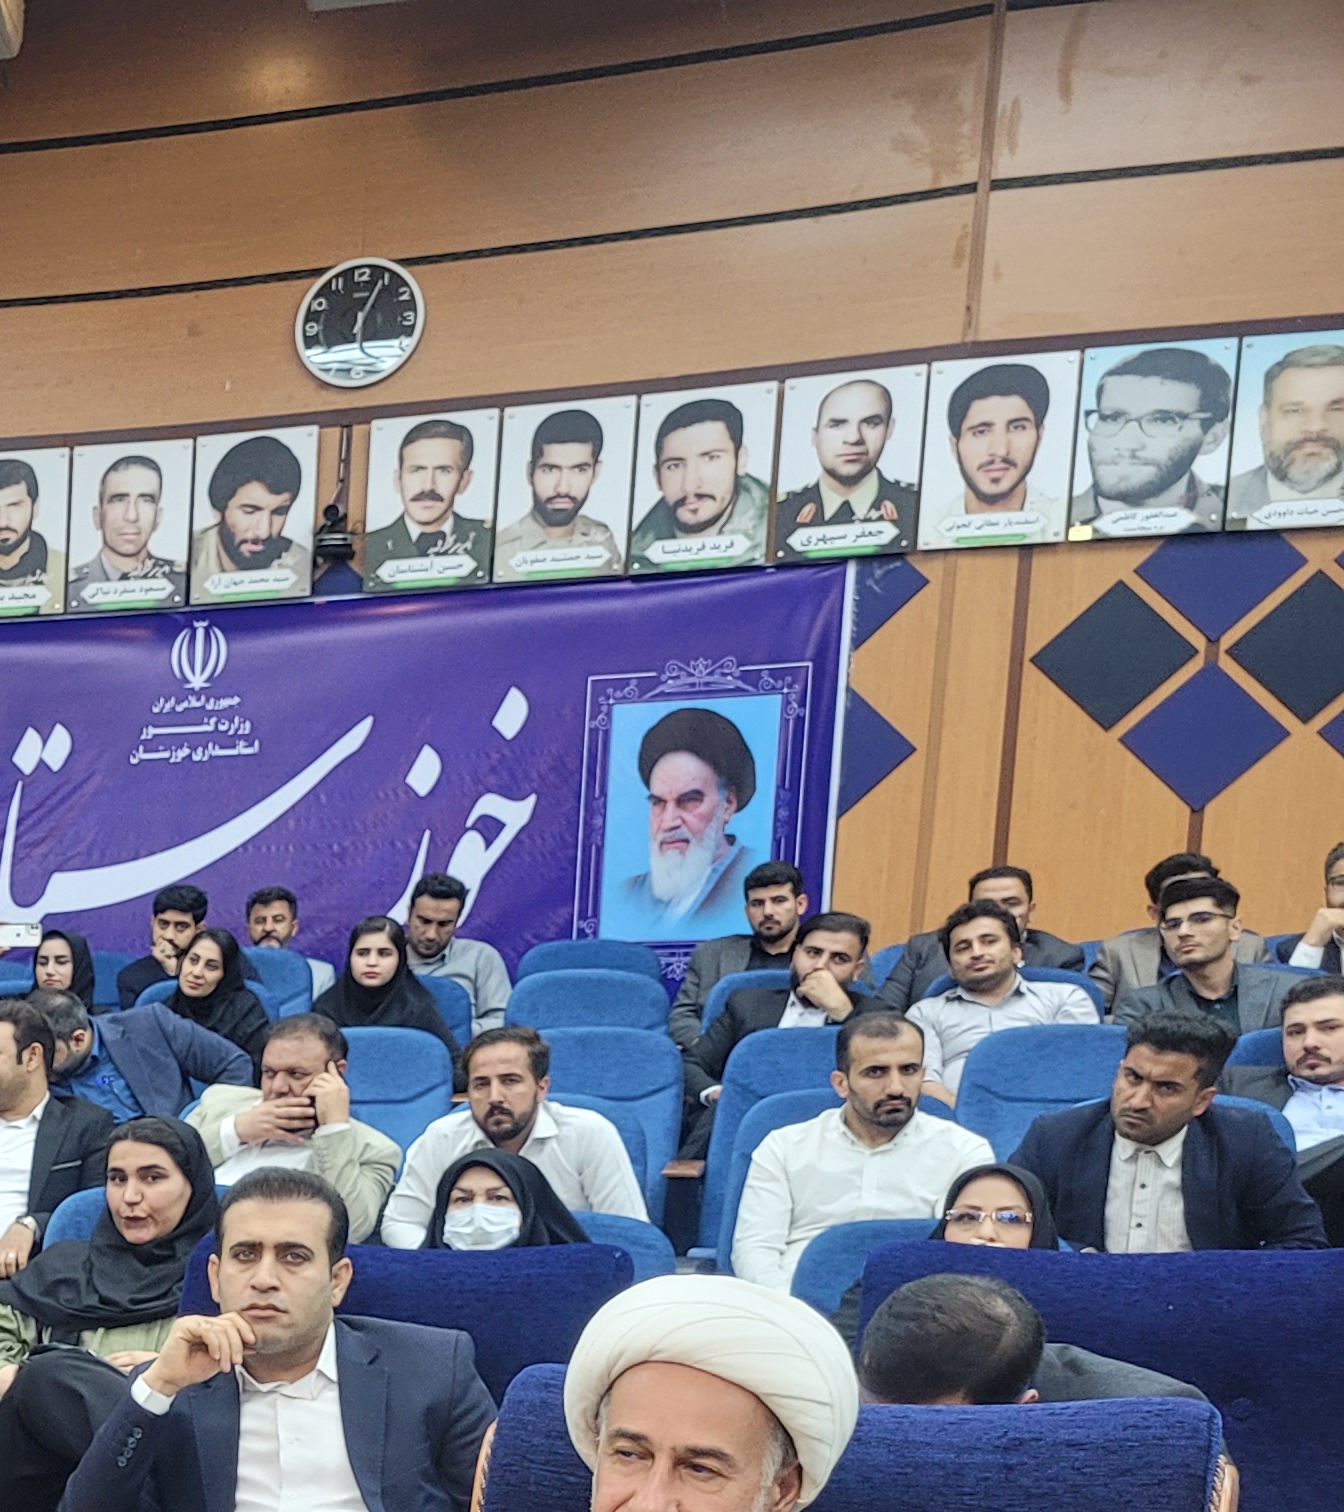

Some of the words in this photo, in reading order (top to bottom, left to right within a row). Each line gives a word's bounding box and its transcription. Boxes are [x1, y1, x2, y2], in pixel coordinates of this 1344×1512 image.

[354, 267, 371, 282] 12
[398, 287, 411, 301] 2
[402, 311, 415, 326] 3
[305, 322, 318, 336] 9
[800, 534, 847, 548] سپهری
[852, 529, 885, 541] جعفر
[246, 578, 270, 587] محمد
[7, 593, 37, 602] مجید
[151, 697, 175, 714] ایران
[175, 694, 206, 712] اسلامی
[205, 694, 242, 711] جمهوری
[140, 716, 218, 740] کشور
[218, 715, 252, 735] وزارت
[129, 742, 191, 765] خوزستان
[191, 738, 260, 762] استانداری
